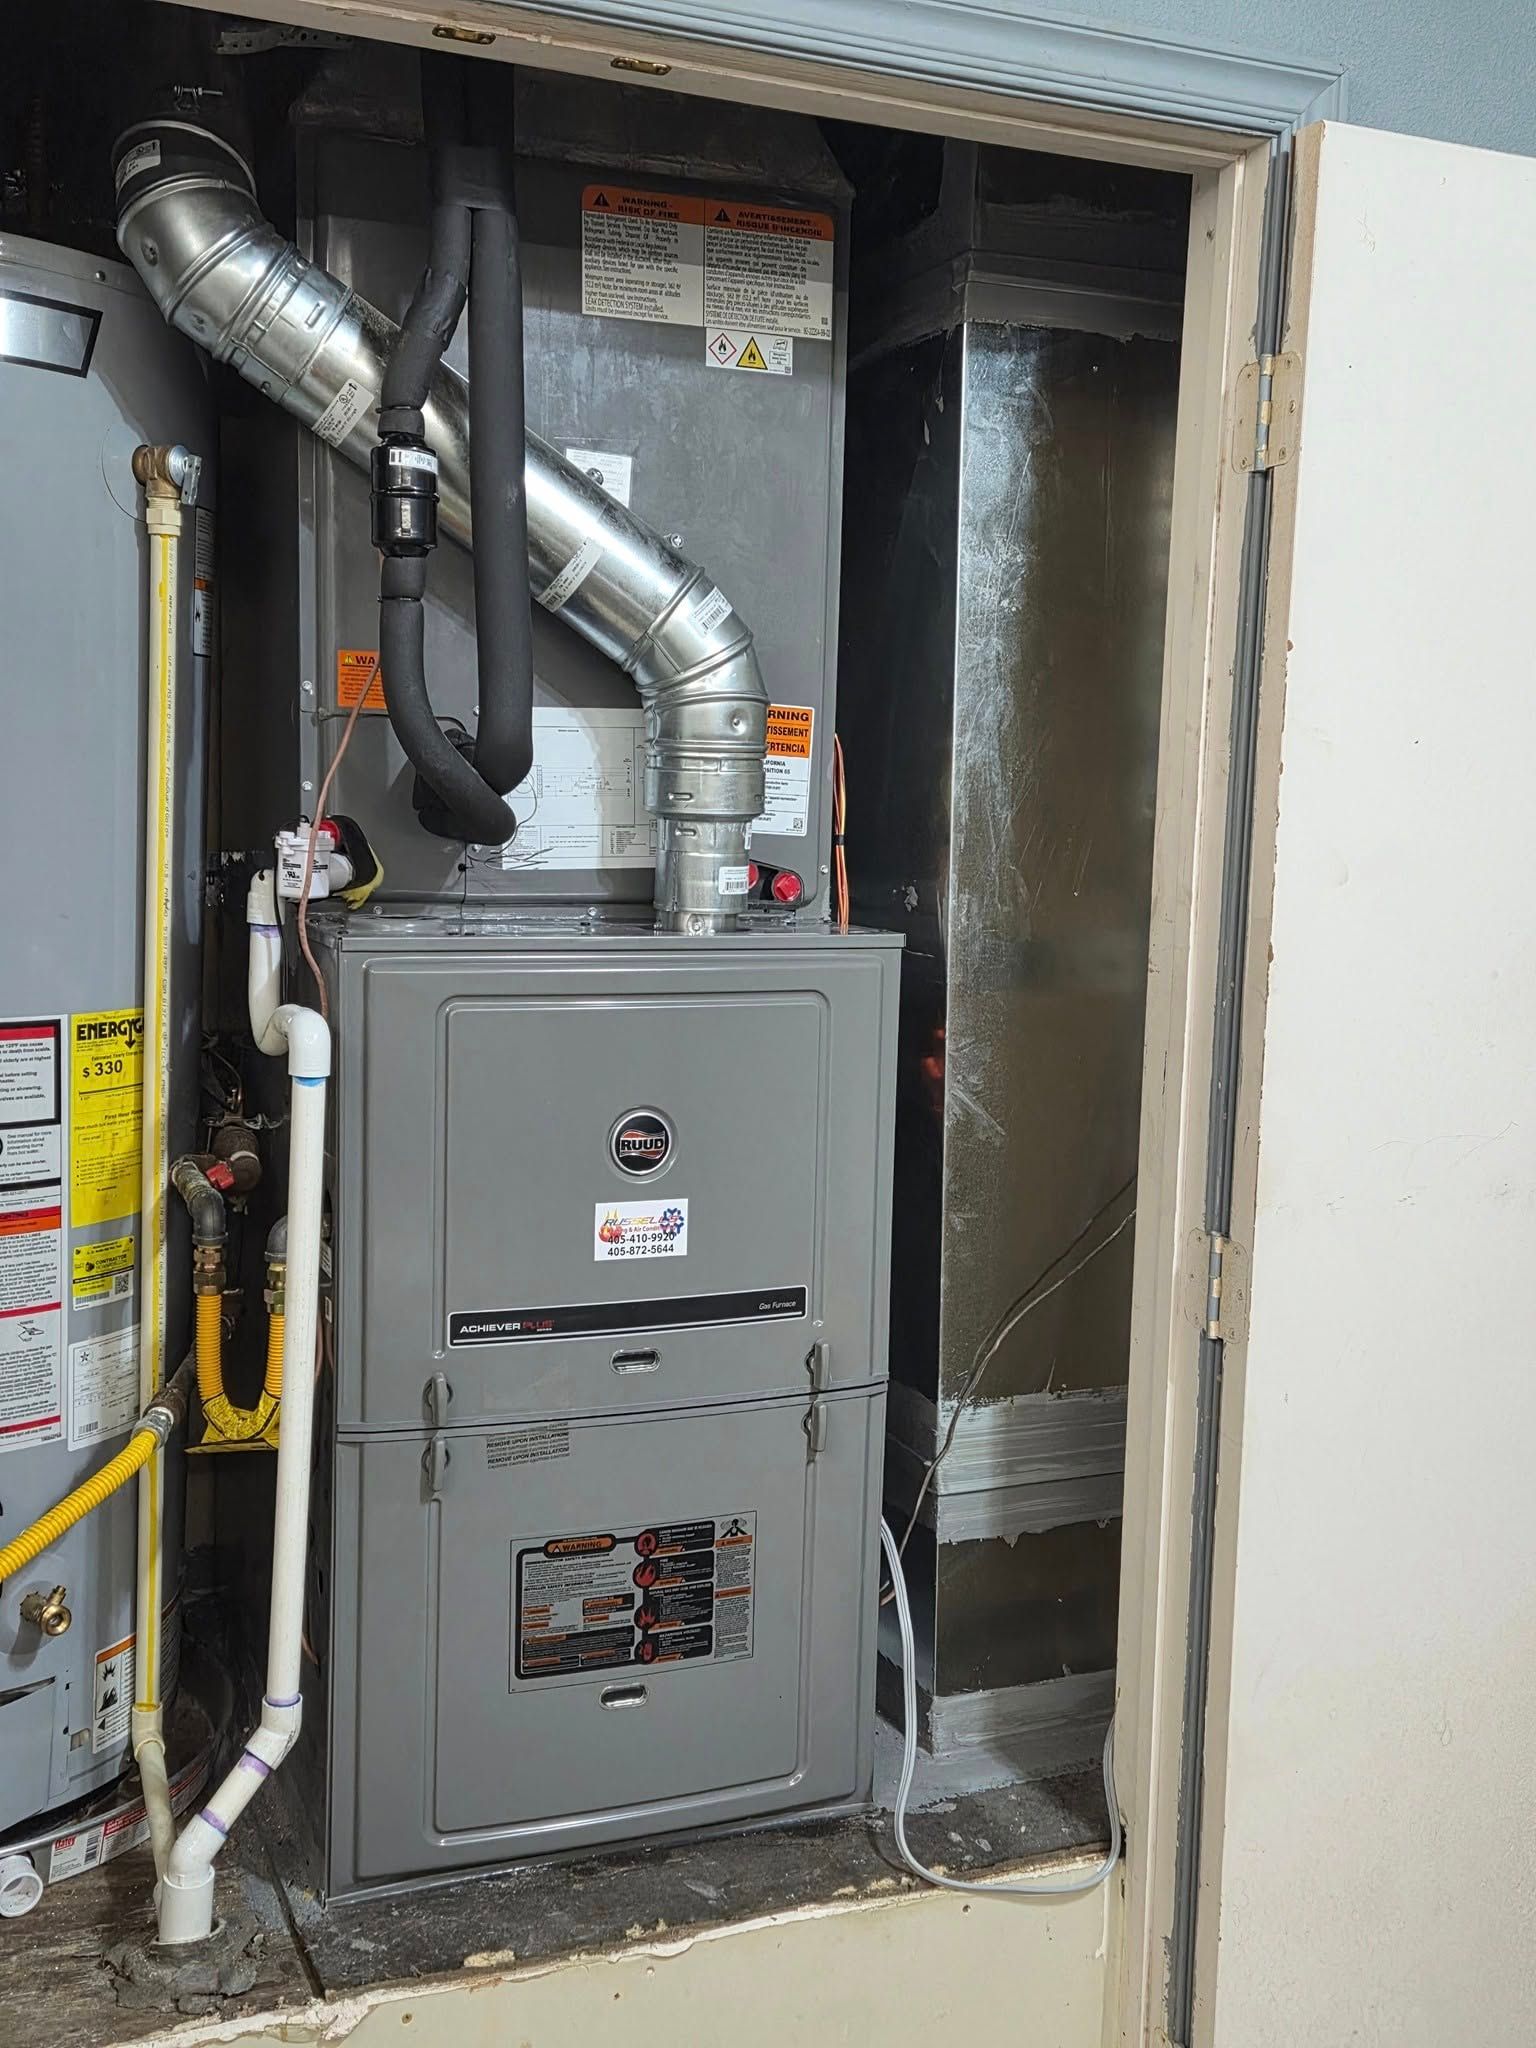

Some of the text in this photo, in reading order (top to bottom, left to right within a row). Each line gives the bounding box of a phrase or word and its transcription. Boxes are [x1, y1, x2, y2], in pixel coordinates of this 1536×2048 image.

[623, 197, 666, 208] WARNING
[618, 206, 640, 215] RISK
[658, 210, 680, 219] FIRE
[768, 710, 809, 722] RNING
[82, 1060, 123, 1078] $ 330
[621, 1138, 664, 1150] RUUD
[608, 1232, 675, 1244] 405-410-9920
[608, 1244, 674, 1256] 405-872-5644
[759, 1301, 796, 1310] Gas Furnace
[460, 1322, 520, 1334] ACHIEVER
[487, 1439, 510, 1448] REMOVE
[512, 1437, 528, 1445] UPON
[488, 1454, 512, 1464] REMOVE
[513, 1452, 529, 1460] UPON
[563, 1540, 602, 1551] WARNING
